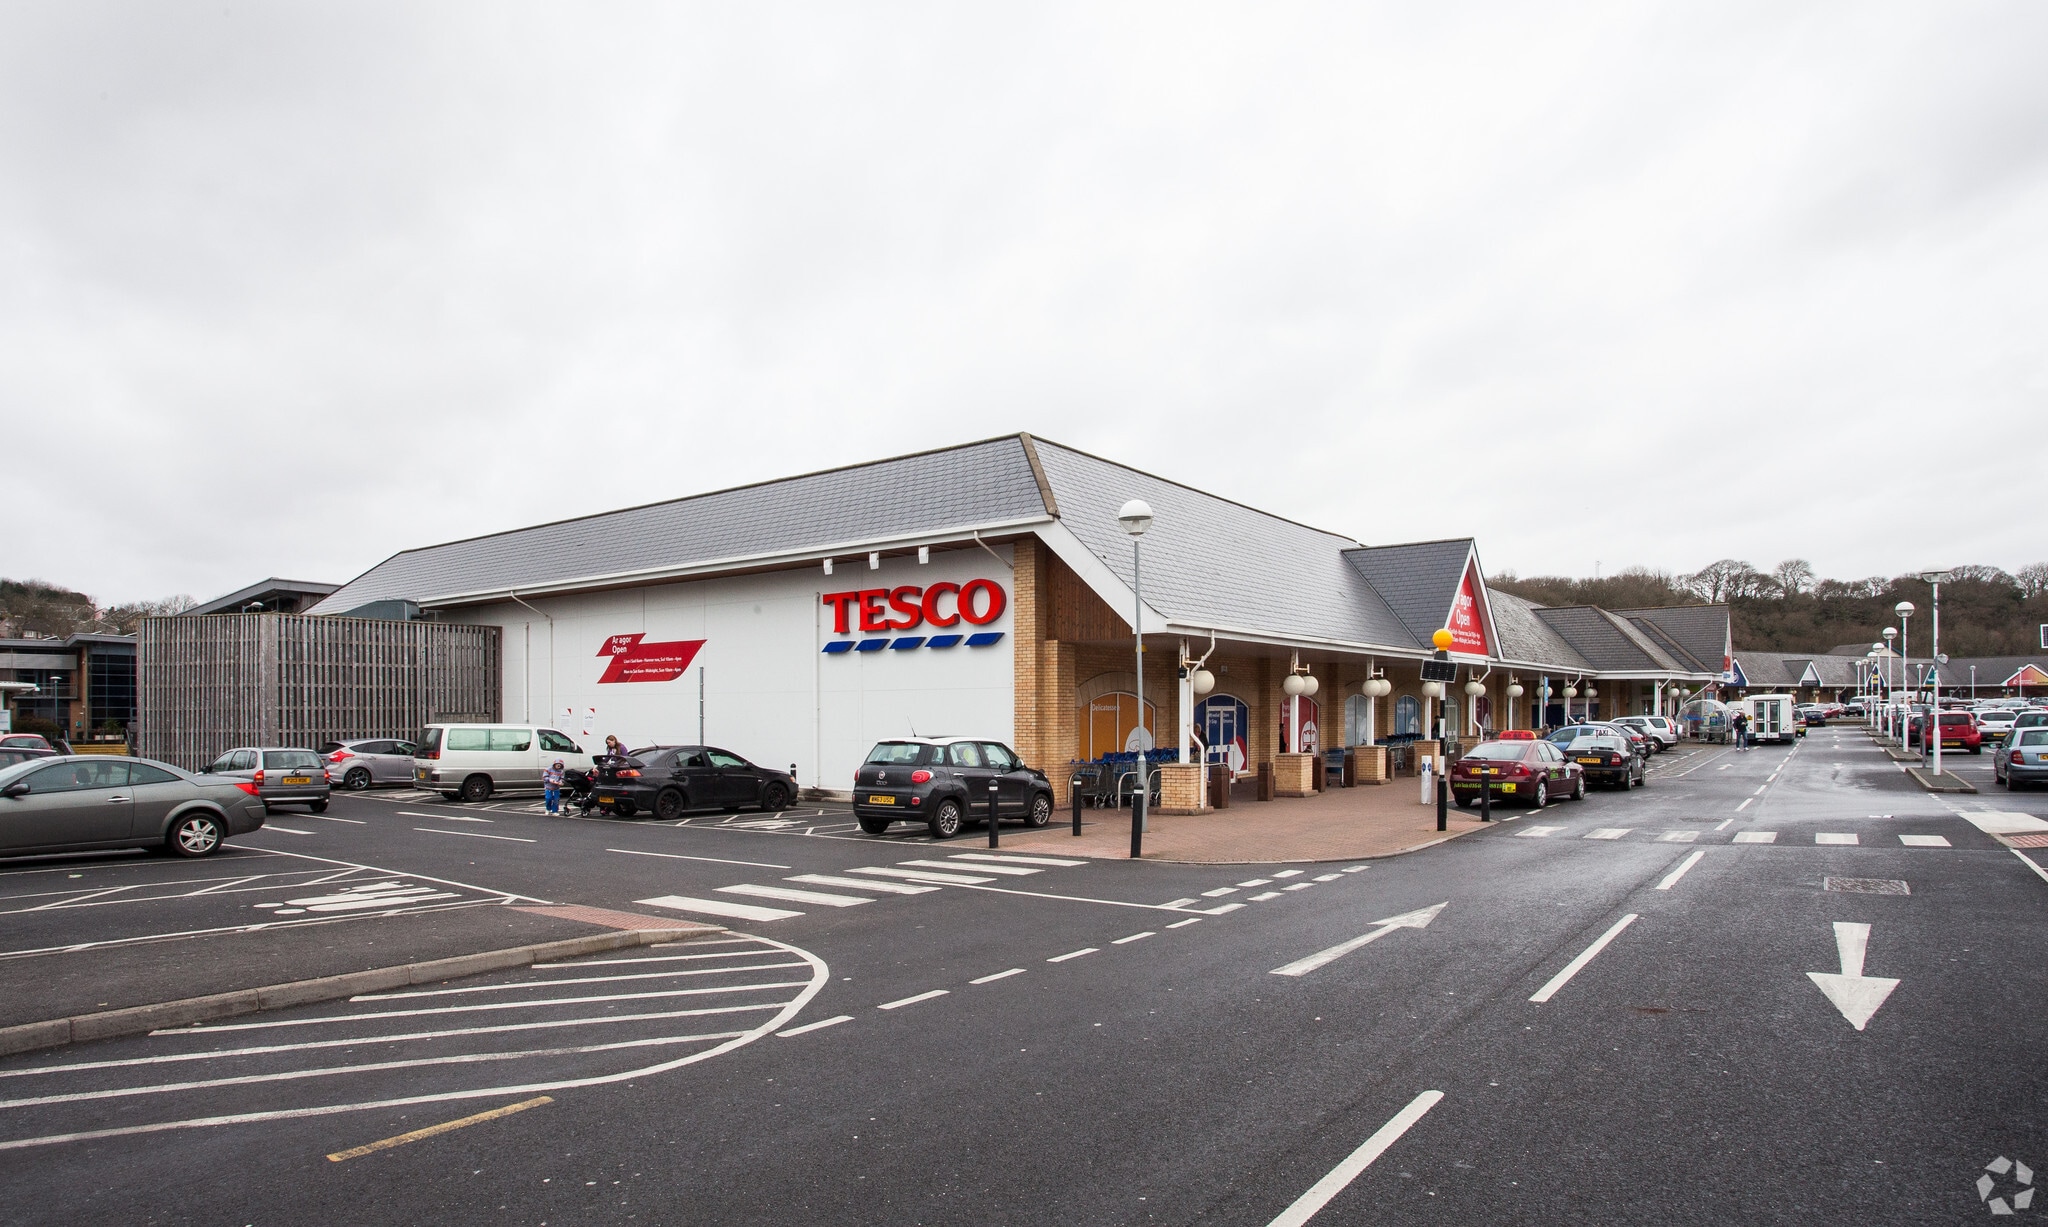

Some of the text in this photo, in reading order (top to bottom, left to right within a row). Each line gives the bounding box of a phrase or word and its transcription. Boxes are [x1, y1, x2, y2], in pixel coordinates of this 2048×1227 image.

[823, 579, 1006, 633] TESCO
[1456, 609, 1470, 628] Open
[619, 637, 631, 645] agor
[612, 646, 627, 654] Open
